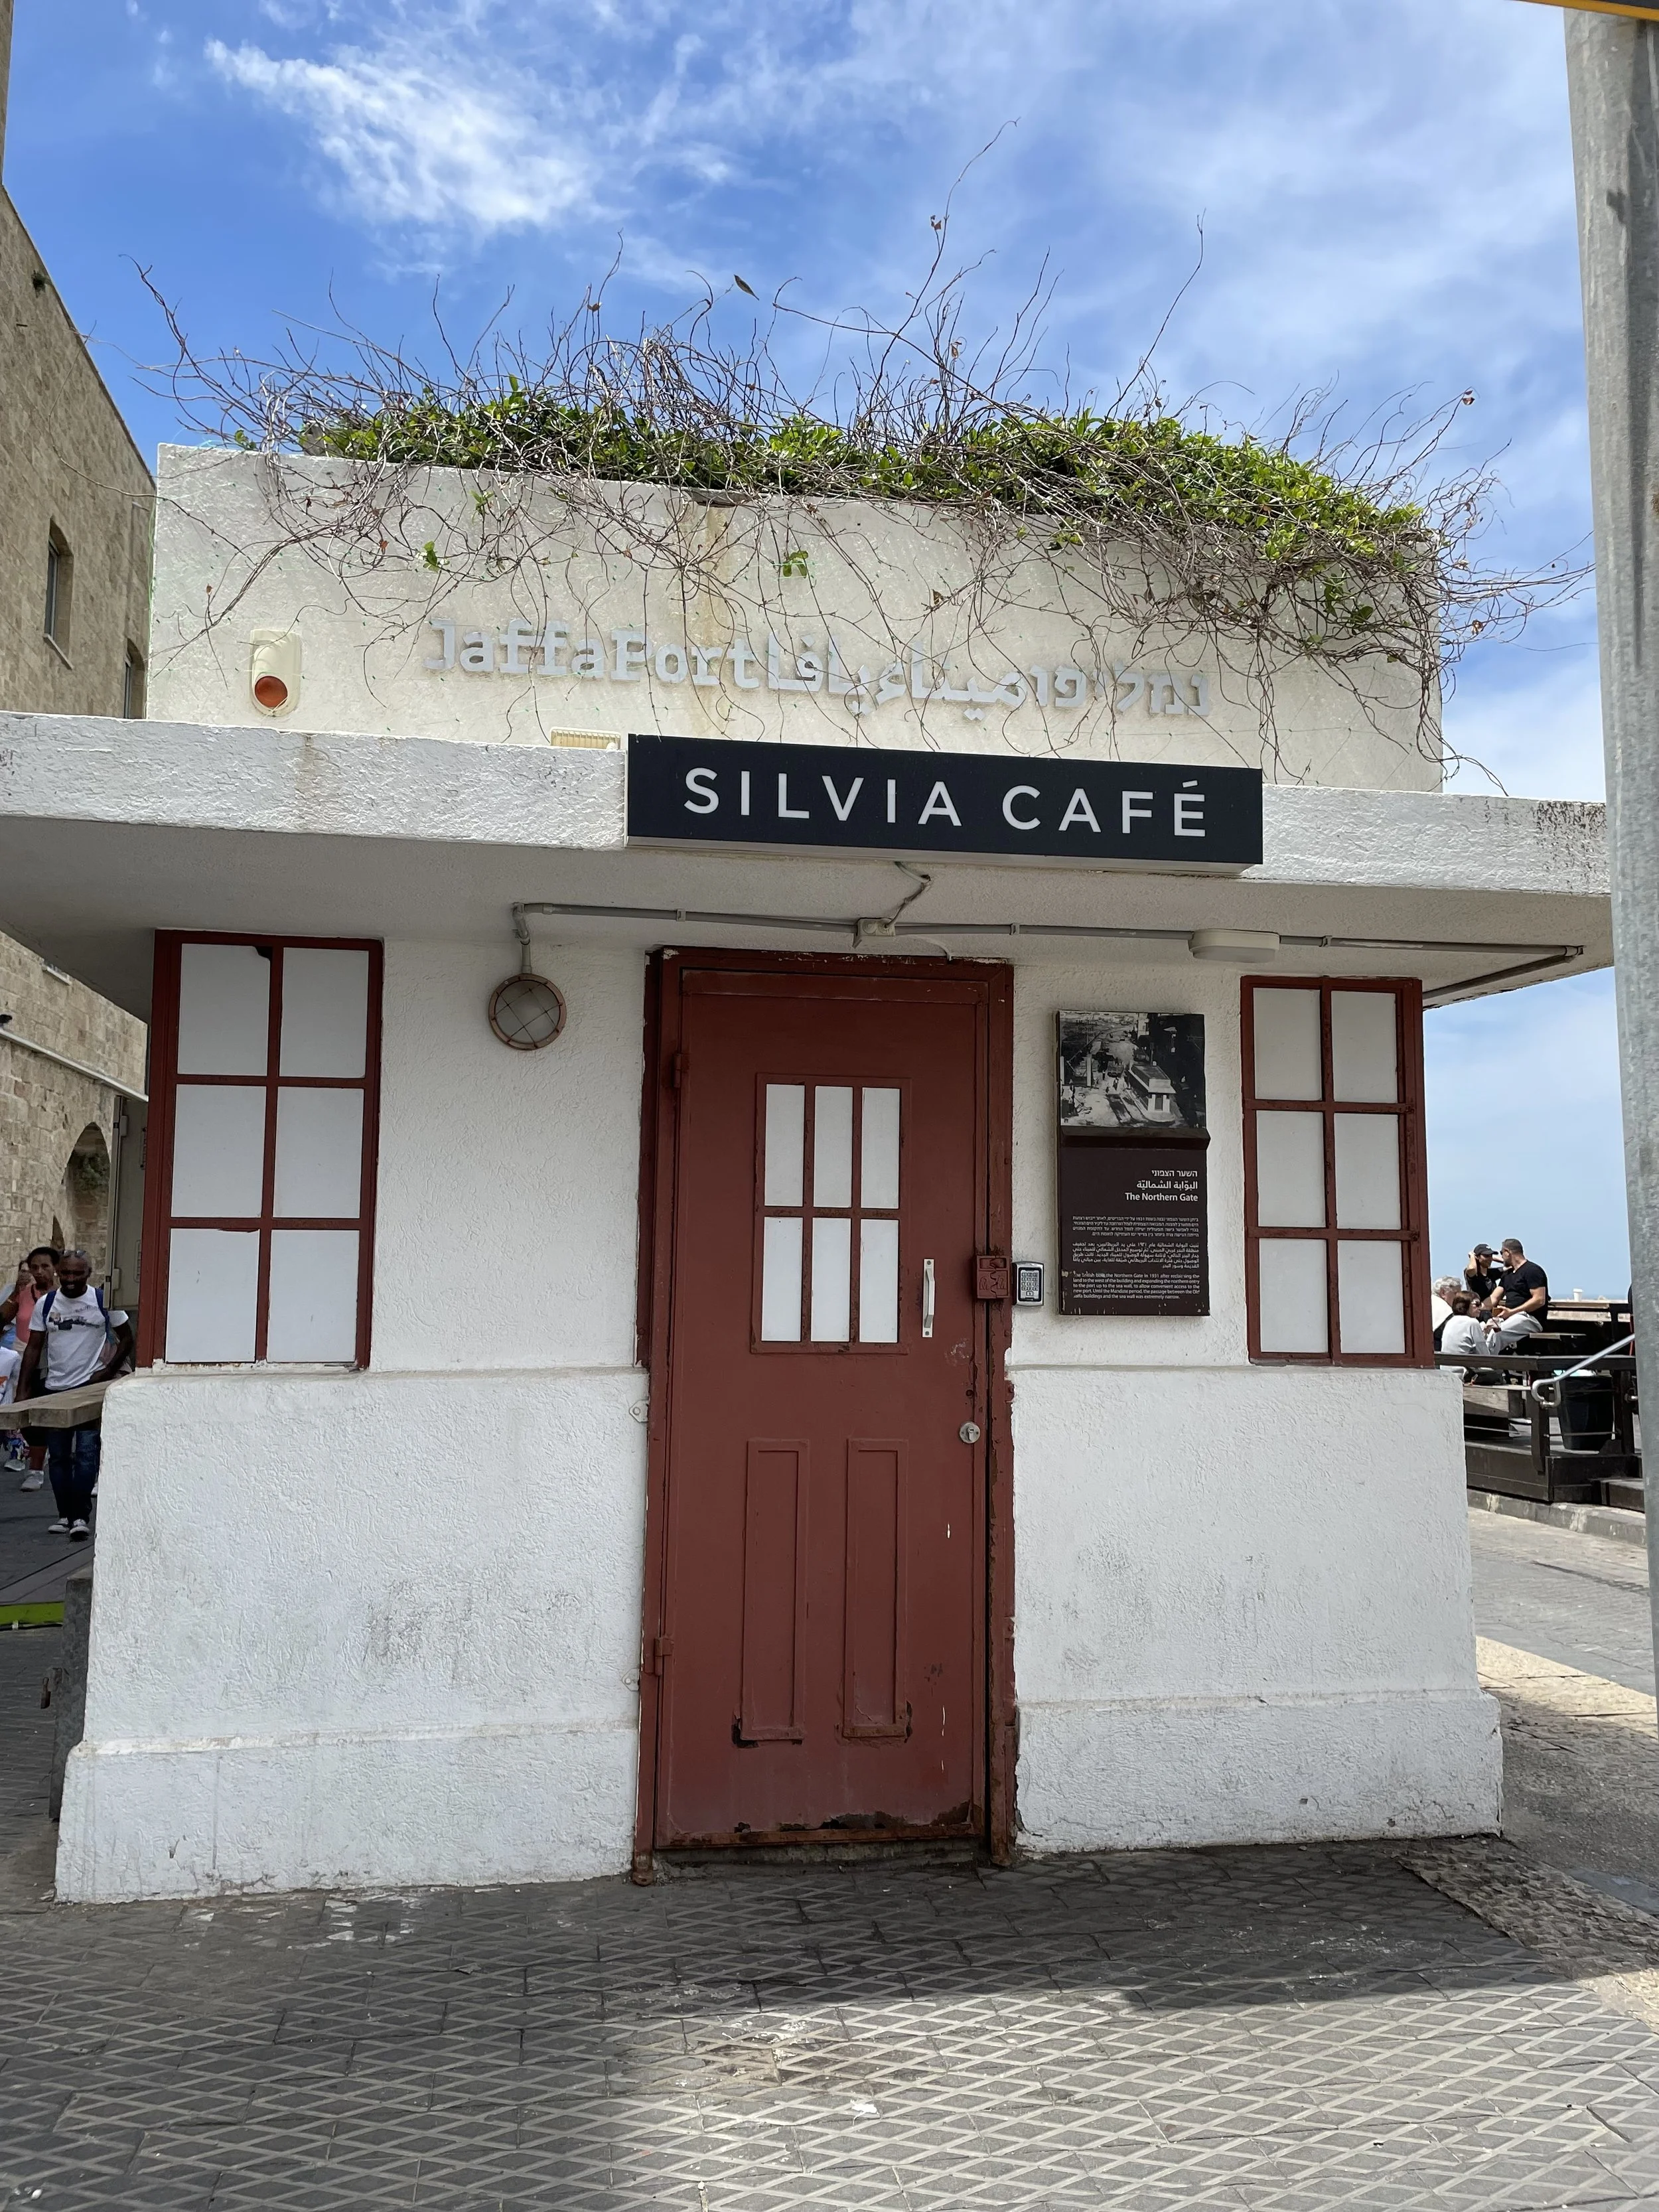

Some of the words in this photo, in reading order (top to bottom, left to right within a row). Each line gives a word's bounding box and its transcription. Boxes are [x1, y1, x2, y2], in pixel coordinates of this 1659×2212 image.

[423, 617, 605, 678] Jaffa
[611, 630, 759, 689] Port
[1114, 659, 1211, 716] נמל
[684, 767, 963, 827] SILVIA
[1002, 780, 1206, 838] CAFÉ
[1125, 1192, 1141, 1201] The
[1141, 1193, 1178, 1201] Northern
[1179, 1193, 1198, 1202] Gate
[1177, 1169, 1198, 1178] השער
